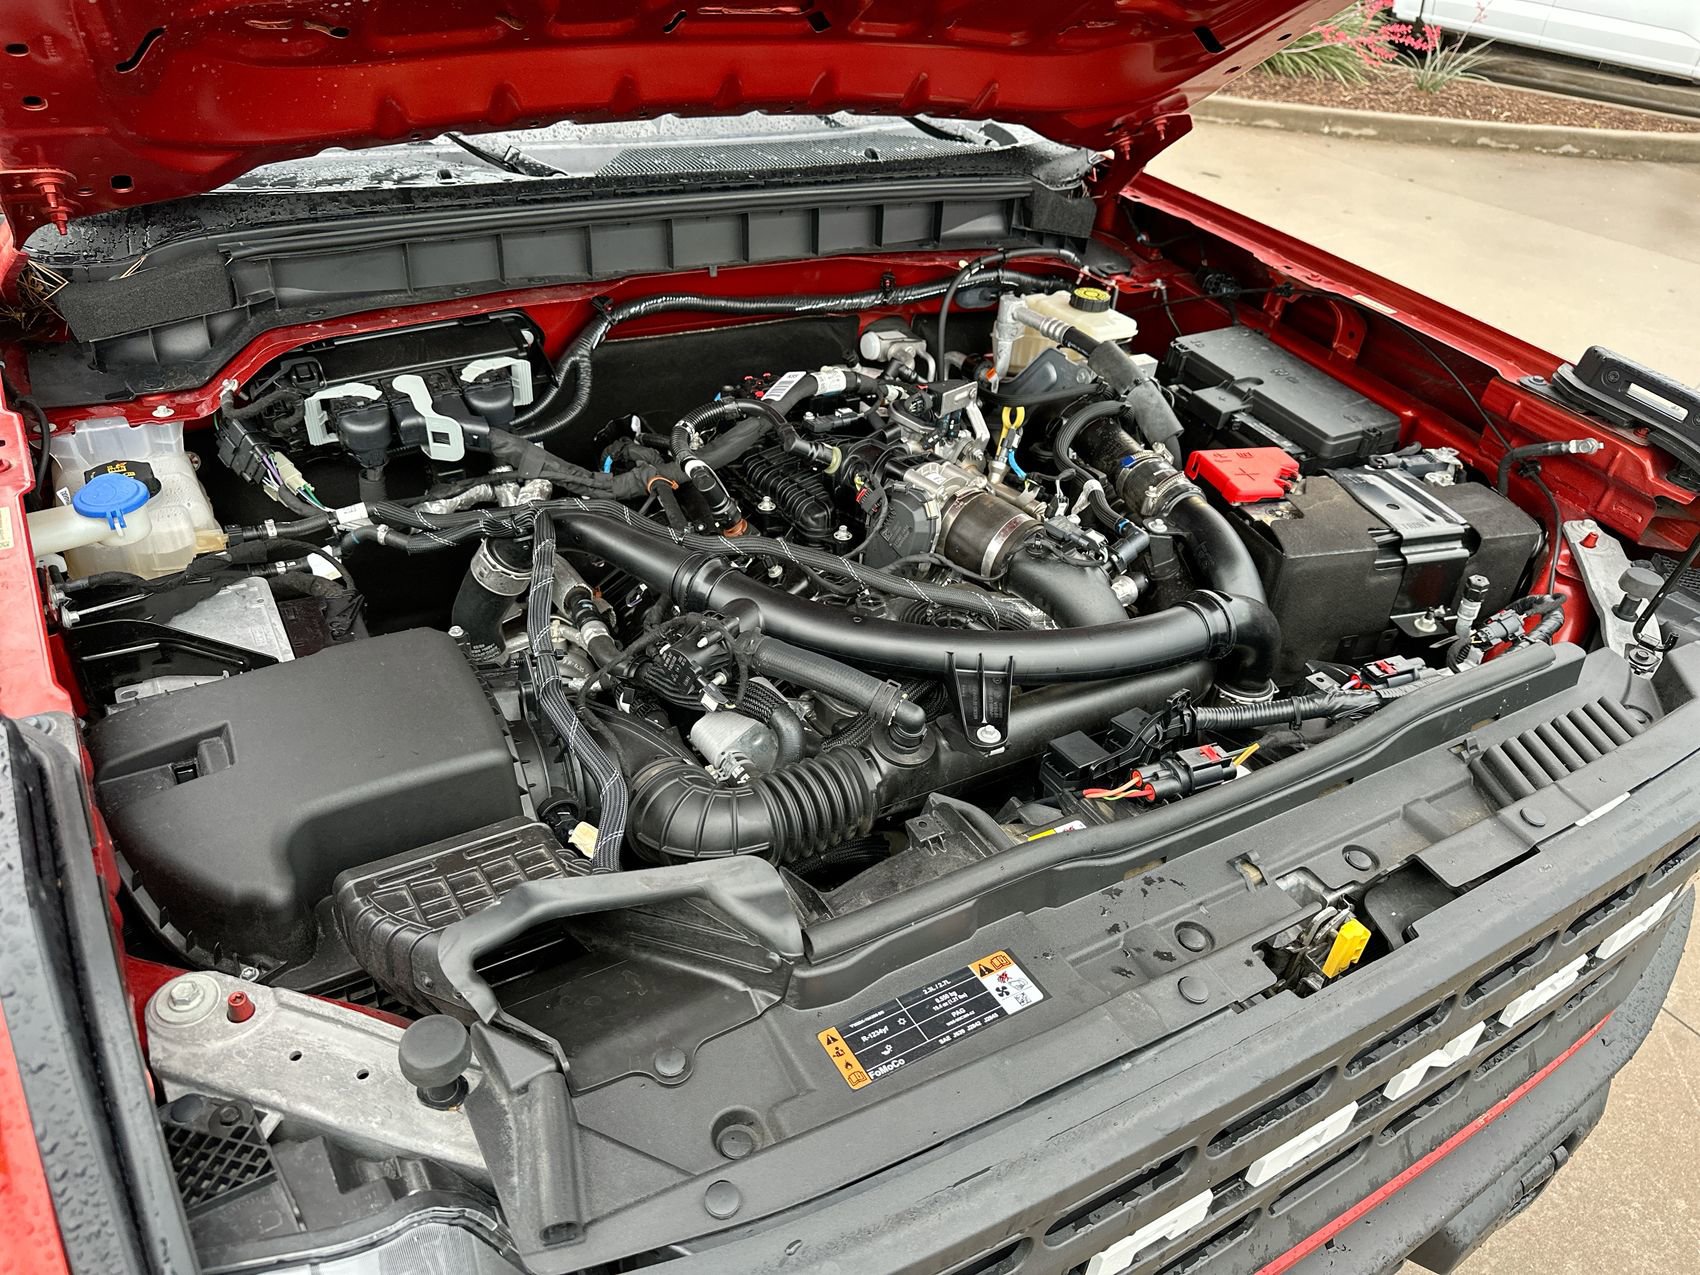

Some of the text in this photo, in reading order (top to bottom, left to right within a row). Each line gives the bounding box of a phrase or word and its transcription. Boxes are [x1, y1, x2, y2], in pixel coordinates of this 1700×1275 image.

[951, 1007, 966, 1018] PAG
[860, 1025, 889, 1043] R-1234yf
[938, 1035, 952, 1045] SAE
[868, 1058, 906, 1080] FoMoCo
